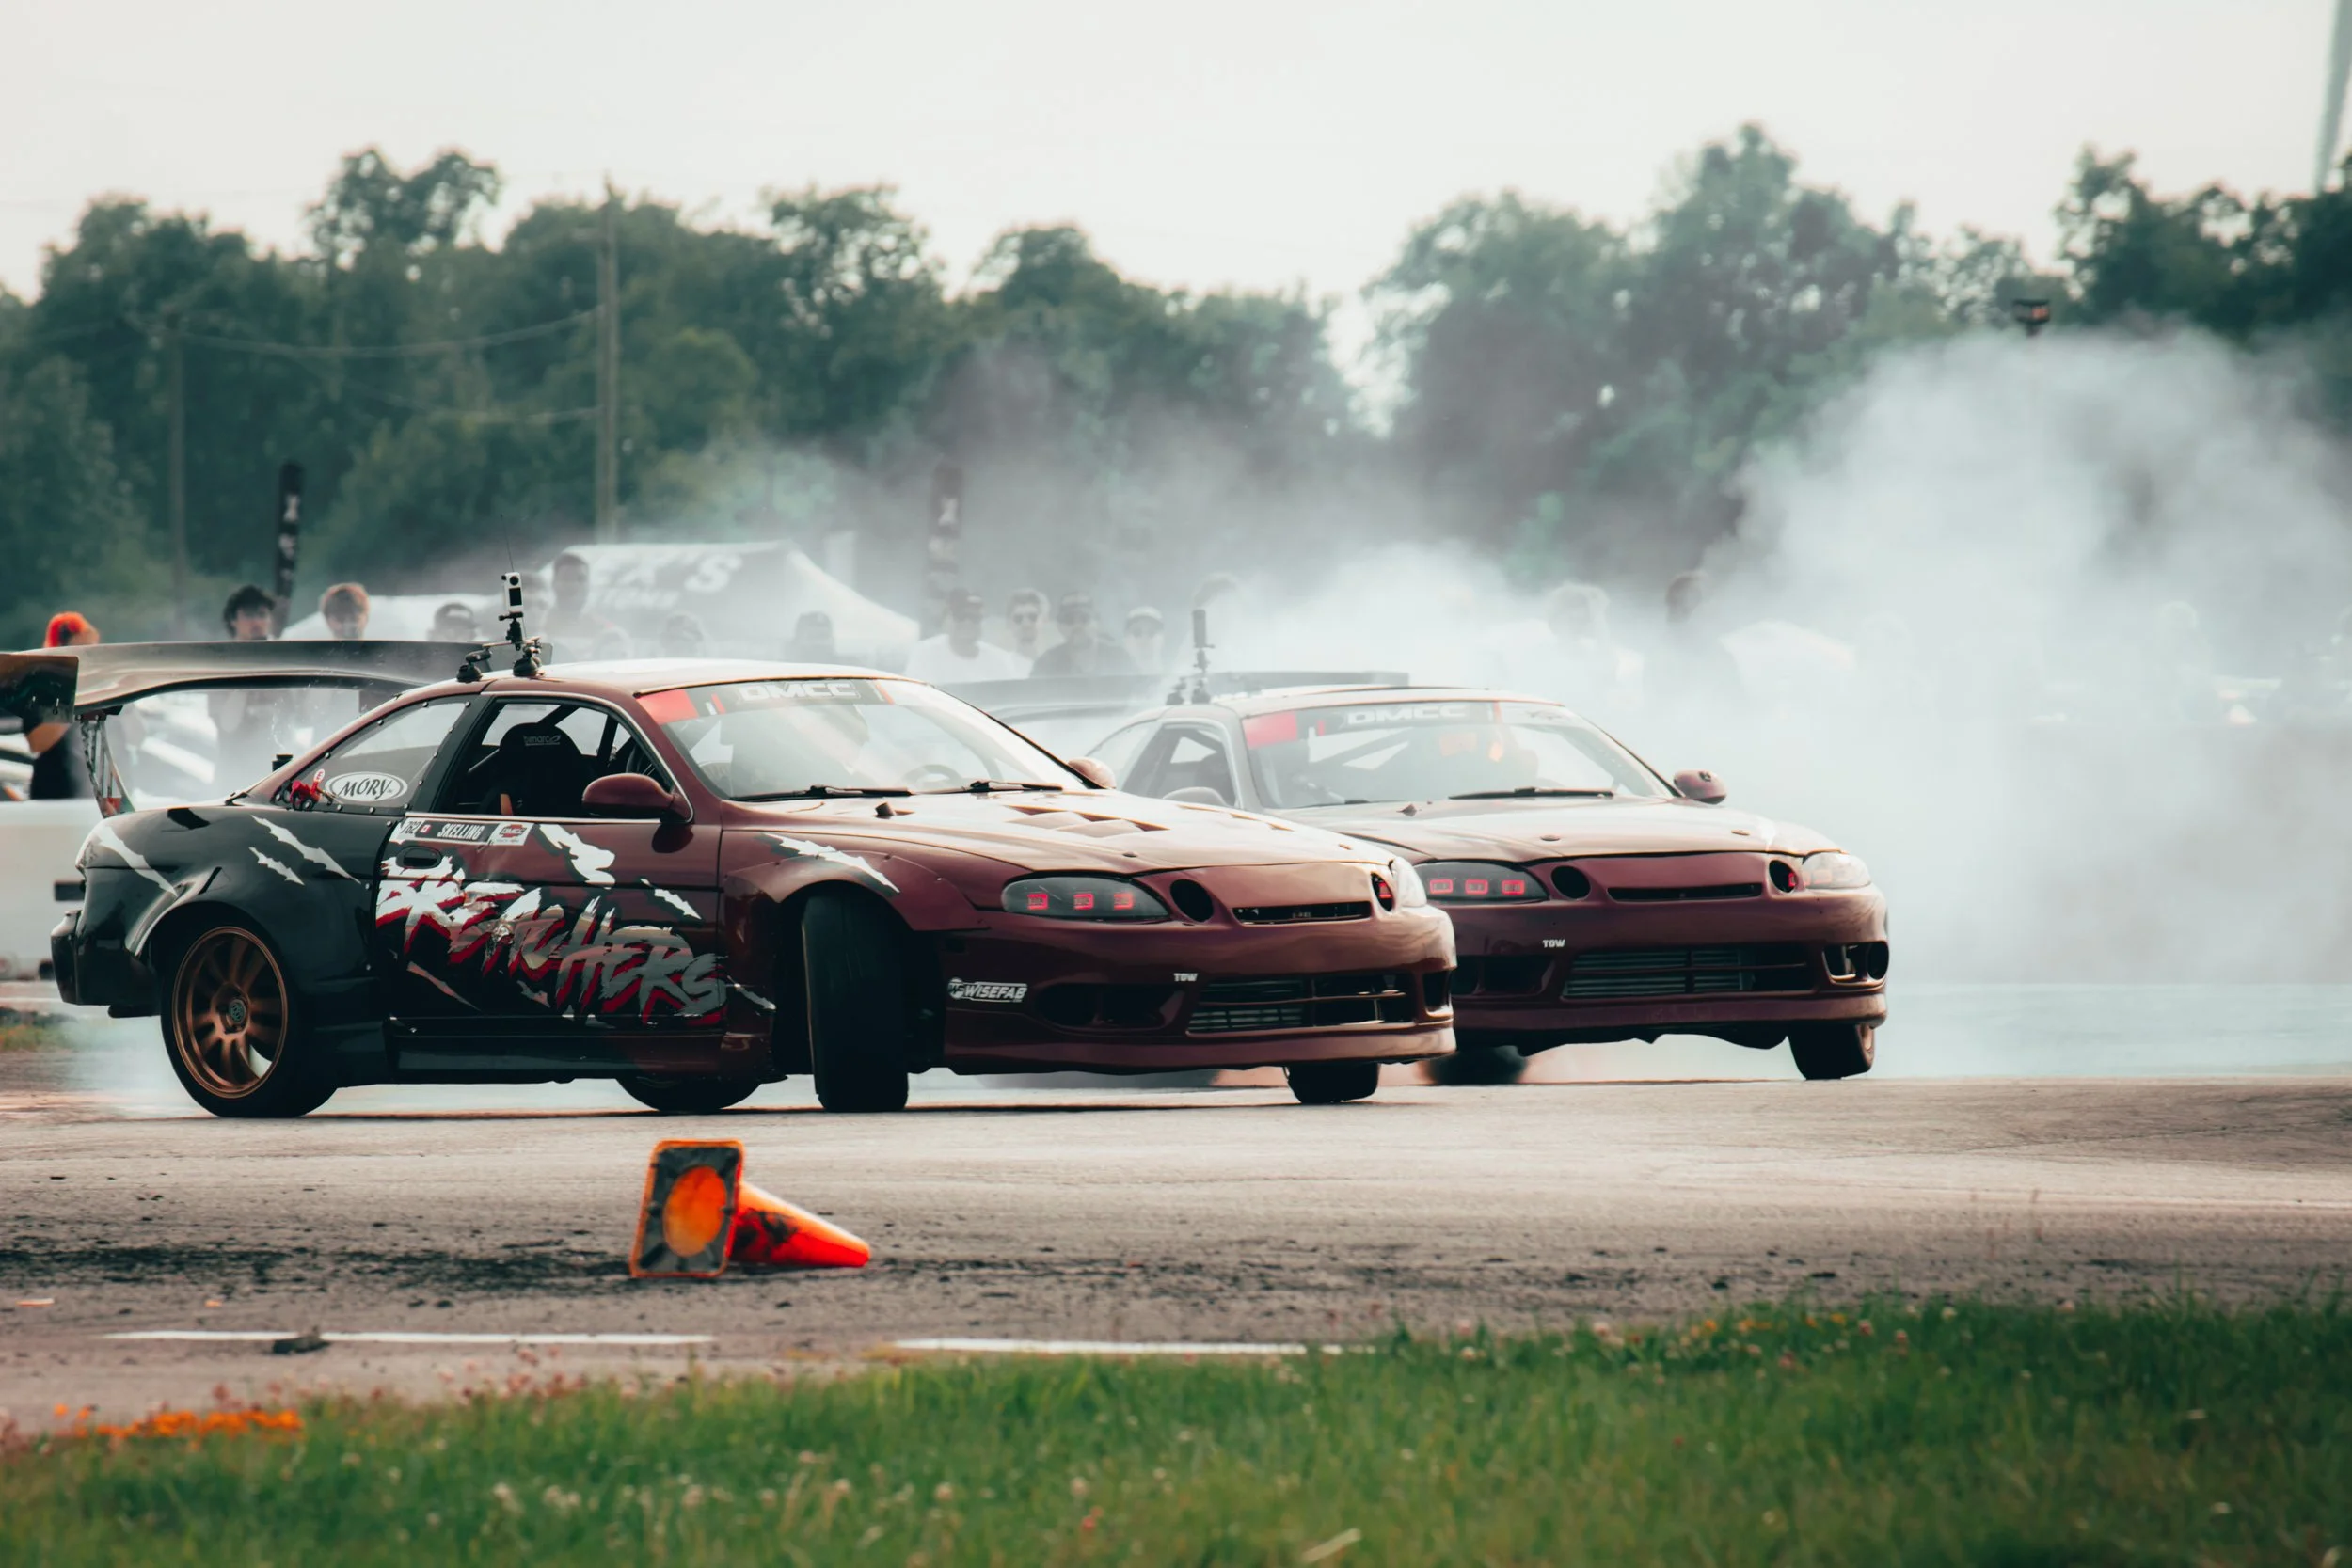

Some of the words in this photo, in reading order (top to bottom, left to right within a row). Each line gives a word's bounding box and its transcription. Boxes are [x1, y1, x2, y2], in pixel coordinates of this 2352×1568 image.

[739, 682, 856, 701] DMCC
[1347, 705, 1468, 724] DMCC
[339, 777, 393, 800] MORY
[437, 823, 485, 841] SKELLING
[1543, 939, 1565, 948] TOW
[1173, 973, 1198, 982] TOW
[964, 984, 1027, 999] WISEFAB
